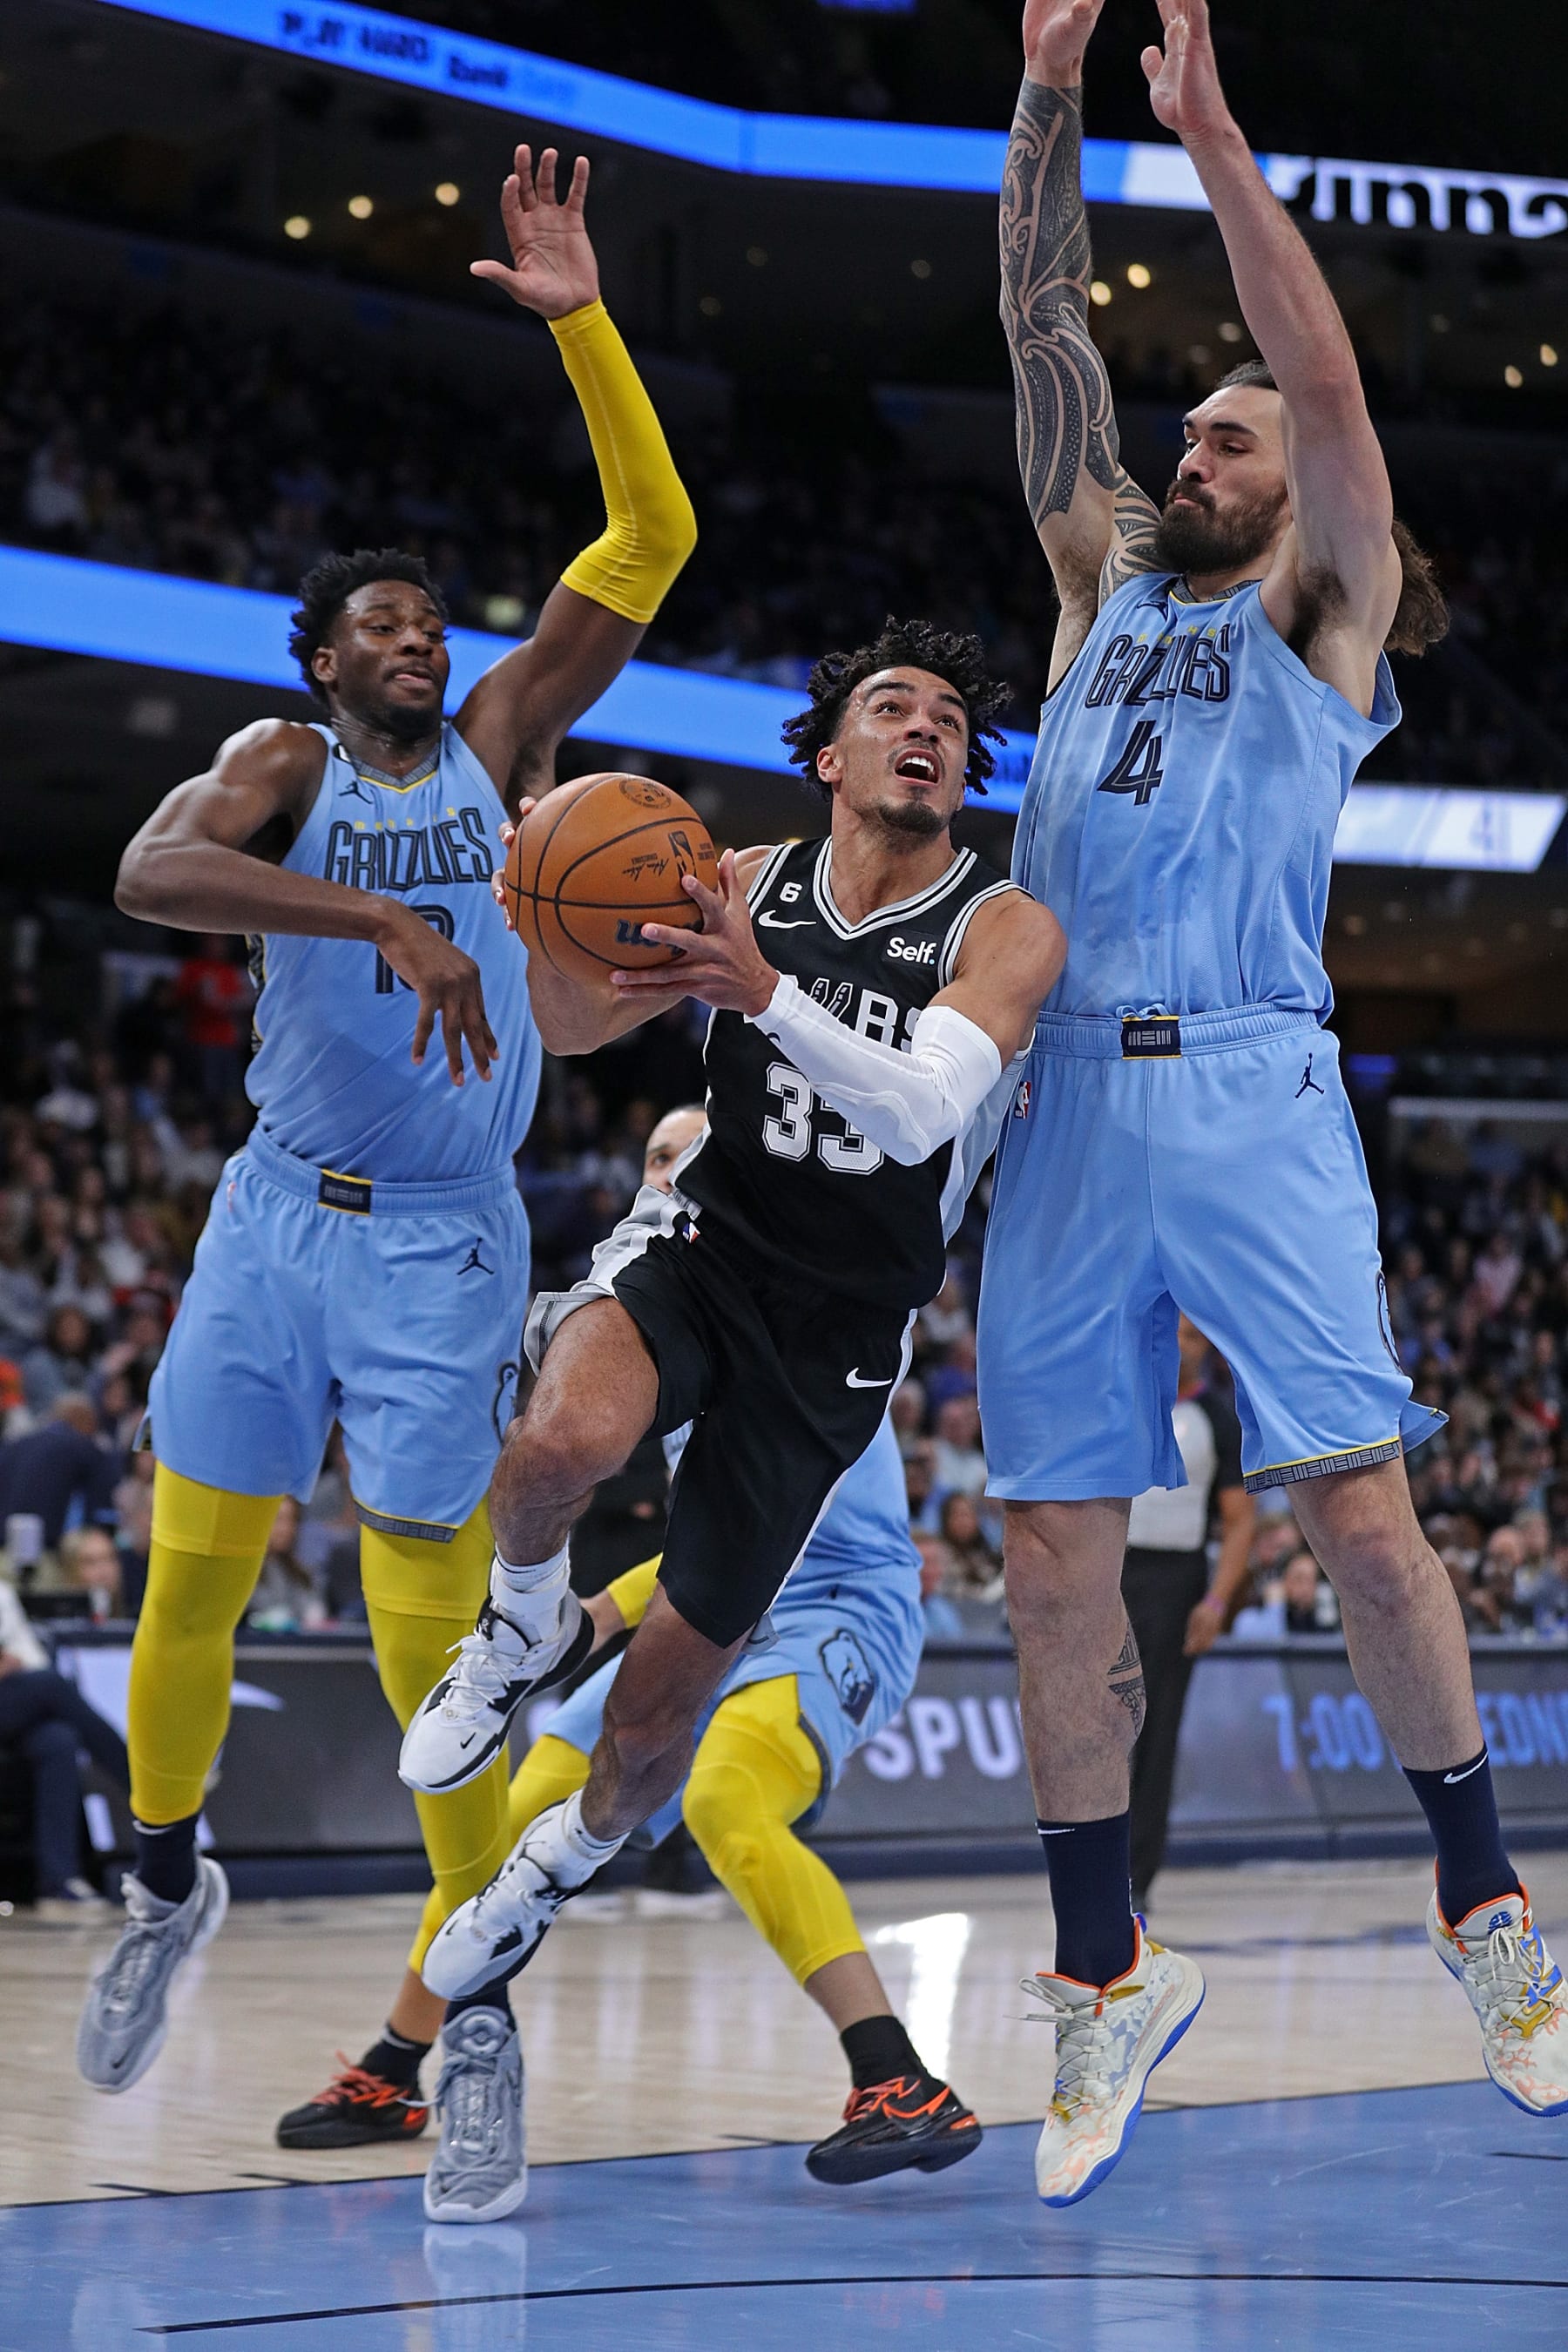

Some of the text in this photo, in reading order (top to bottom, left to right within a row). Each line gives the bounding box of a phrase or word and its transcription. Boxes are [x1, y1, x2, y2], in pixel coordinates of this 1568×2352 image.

[1097, 720, 1164, 806] 4
[779, 882, 803, 903] 6
[886, 936, 937, 965] Self.
[863, 1696, 1023, 1781] SPU
